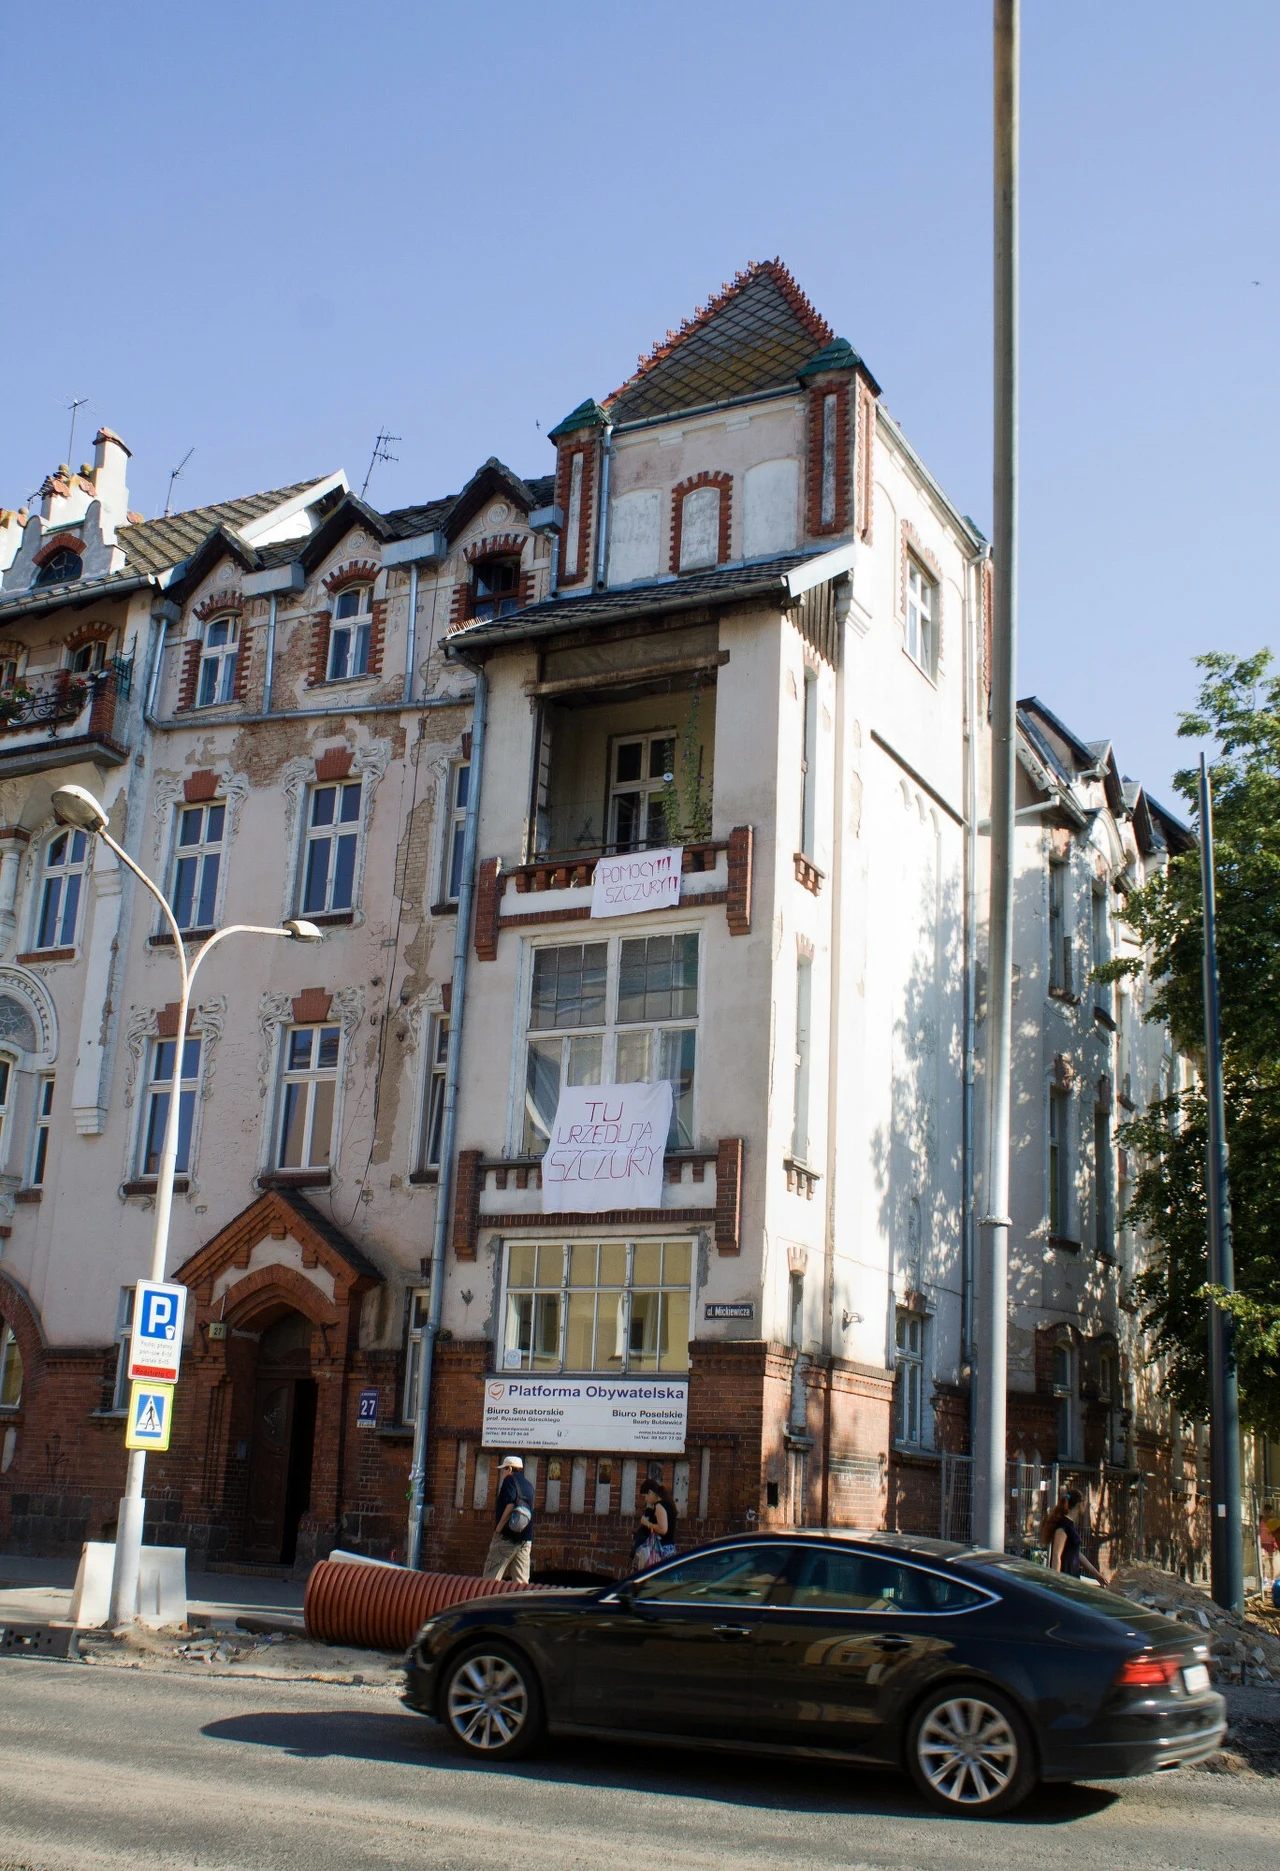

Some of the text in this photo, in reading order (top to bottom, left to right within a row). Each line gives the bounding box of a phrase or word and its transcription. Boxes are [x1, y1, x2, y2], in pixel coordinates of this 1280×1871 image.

[602, 856, 671, 884] POMOCY!!!
[605, 876, 678, 904] SZCZURY!!
[585, 1101, 624, 1122] TU
[548, 1145, 661, 1182] SZCZURY
[147, 1295, 172, 1333] P
[213, 1327, 223, 1336] 27
[509, 1385, 684, 1400] Platforma Obywatelska
[360, 1400, 375, 1415] 27
[487, 1407, 564, 1416] Biuro Senatorskie
[639, 1410, 683, 1418] Poselskie
